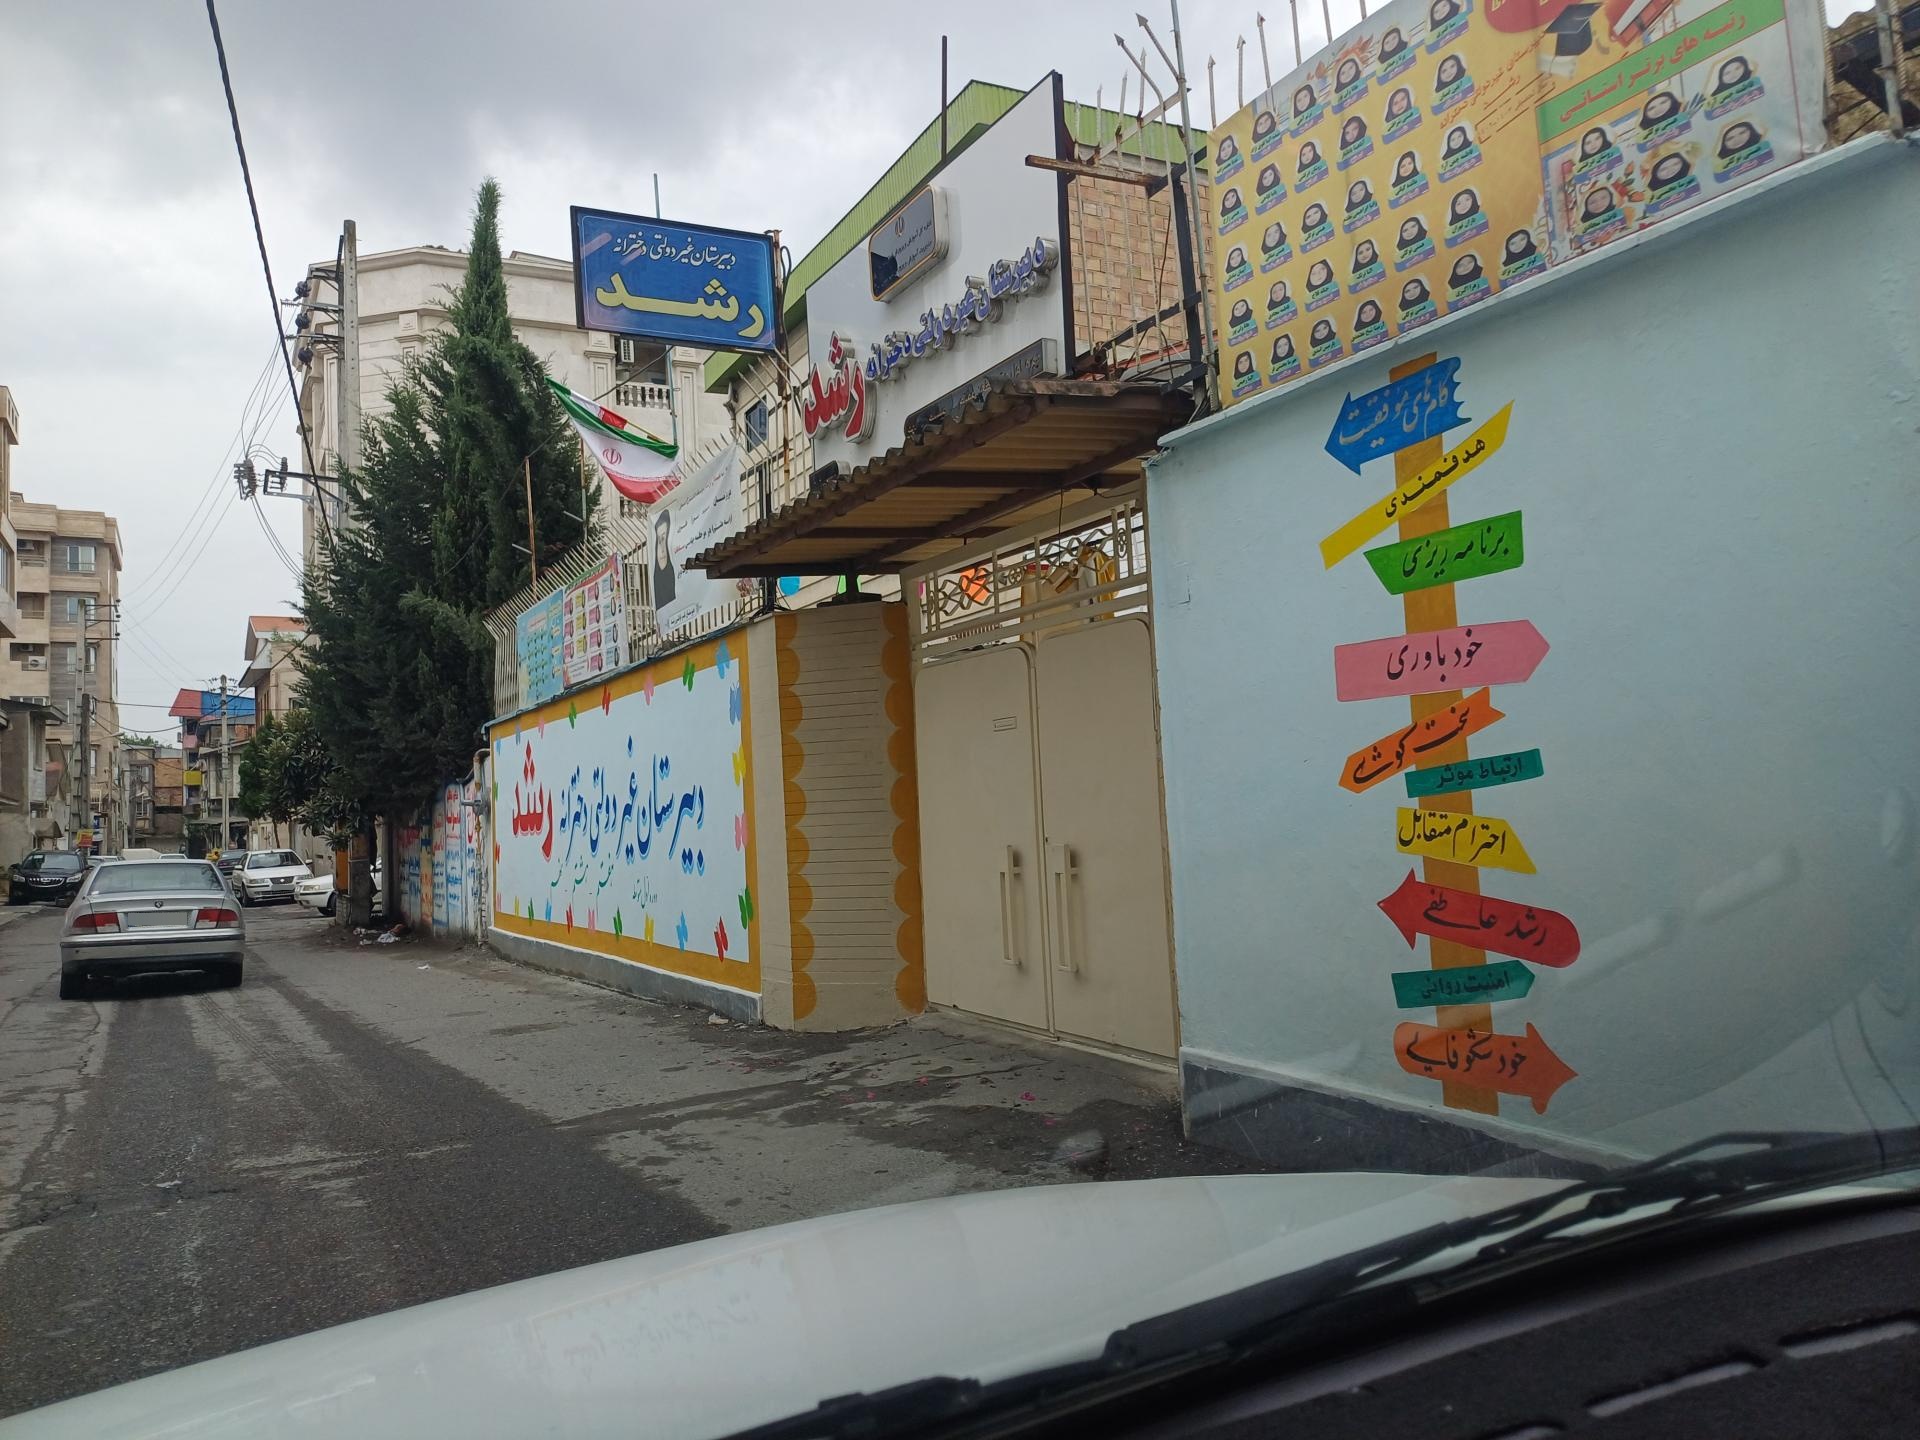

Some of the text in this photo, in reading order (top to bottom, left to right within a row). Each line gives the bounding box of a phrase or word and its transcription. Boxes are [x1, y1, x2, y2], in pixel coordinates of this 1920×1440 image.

[1671, 36, 1699, 64] های
[1703, 14, 1746, 40] رتبه
[1627, 51, 1666, 79] برتر
[1560, 68, 1624, 122] استانی
[612, 231, 647, 256] دخترانه
[690, 245, 737, 270] دبیرستان
[594, 271, 766, 339] رشد
[975, 236, 1050, 322] دبیرستان
[865, 332, 914, 380] دخترانه
[803, 330, 866, 442] رشد
[1338, 387, 1409, 449] موفقیت
[1385, 438, 1486, 518] هدفمندی
[1402, 525, 1509, 579] برنامه ریزی
[1387, 628, 1483, 682] خود باوری
[1353, 706, 1470, 784] سخت کوشی
[1479, 757, 1522, 783] ارتباط
[512, 739, 553, 862] رشد
[560, 765, 588, 866] دخترانه
[637, 753, 705, 876] دبیرستان
[1398, 808, 1506, 863] احترام متقابل
[1422, 887, 1548, 946] رشد عاطفی
[1421, 970, 1511, 999] امنیت روانی
[1497, 1041, 1527, 1077] خود
